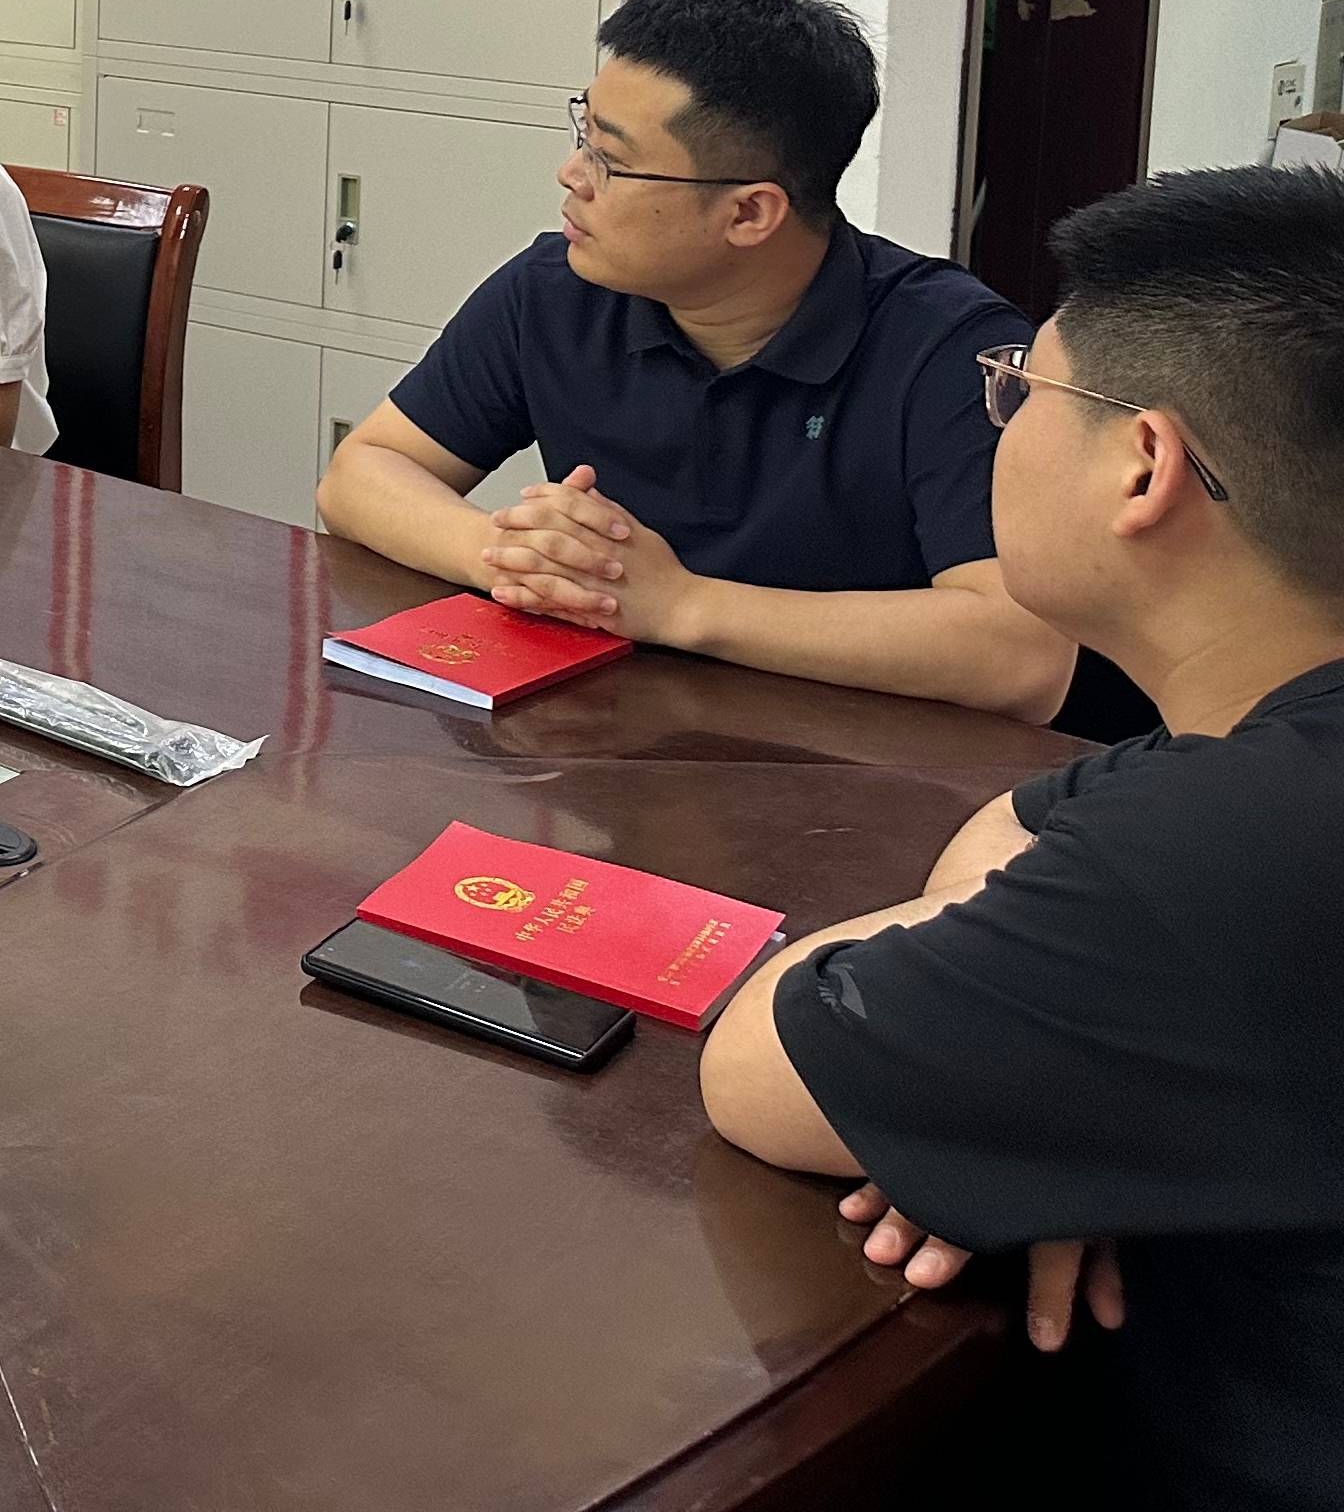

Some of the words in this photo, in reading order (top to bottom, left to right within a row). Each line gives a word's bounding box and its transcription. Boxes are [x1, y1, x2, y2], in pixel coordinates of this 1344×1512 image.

[514, 878, 589, 942] 中华人民共和国
[556, 905, 597, 935] 民法典
